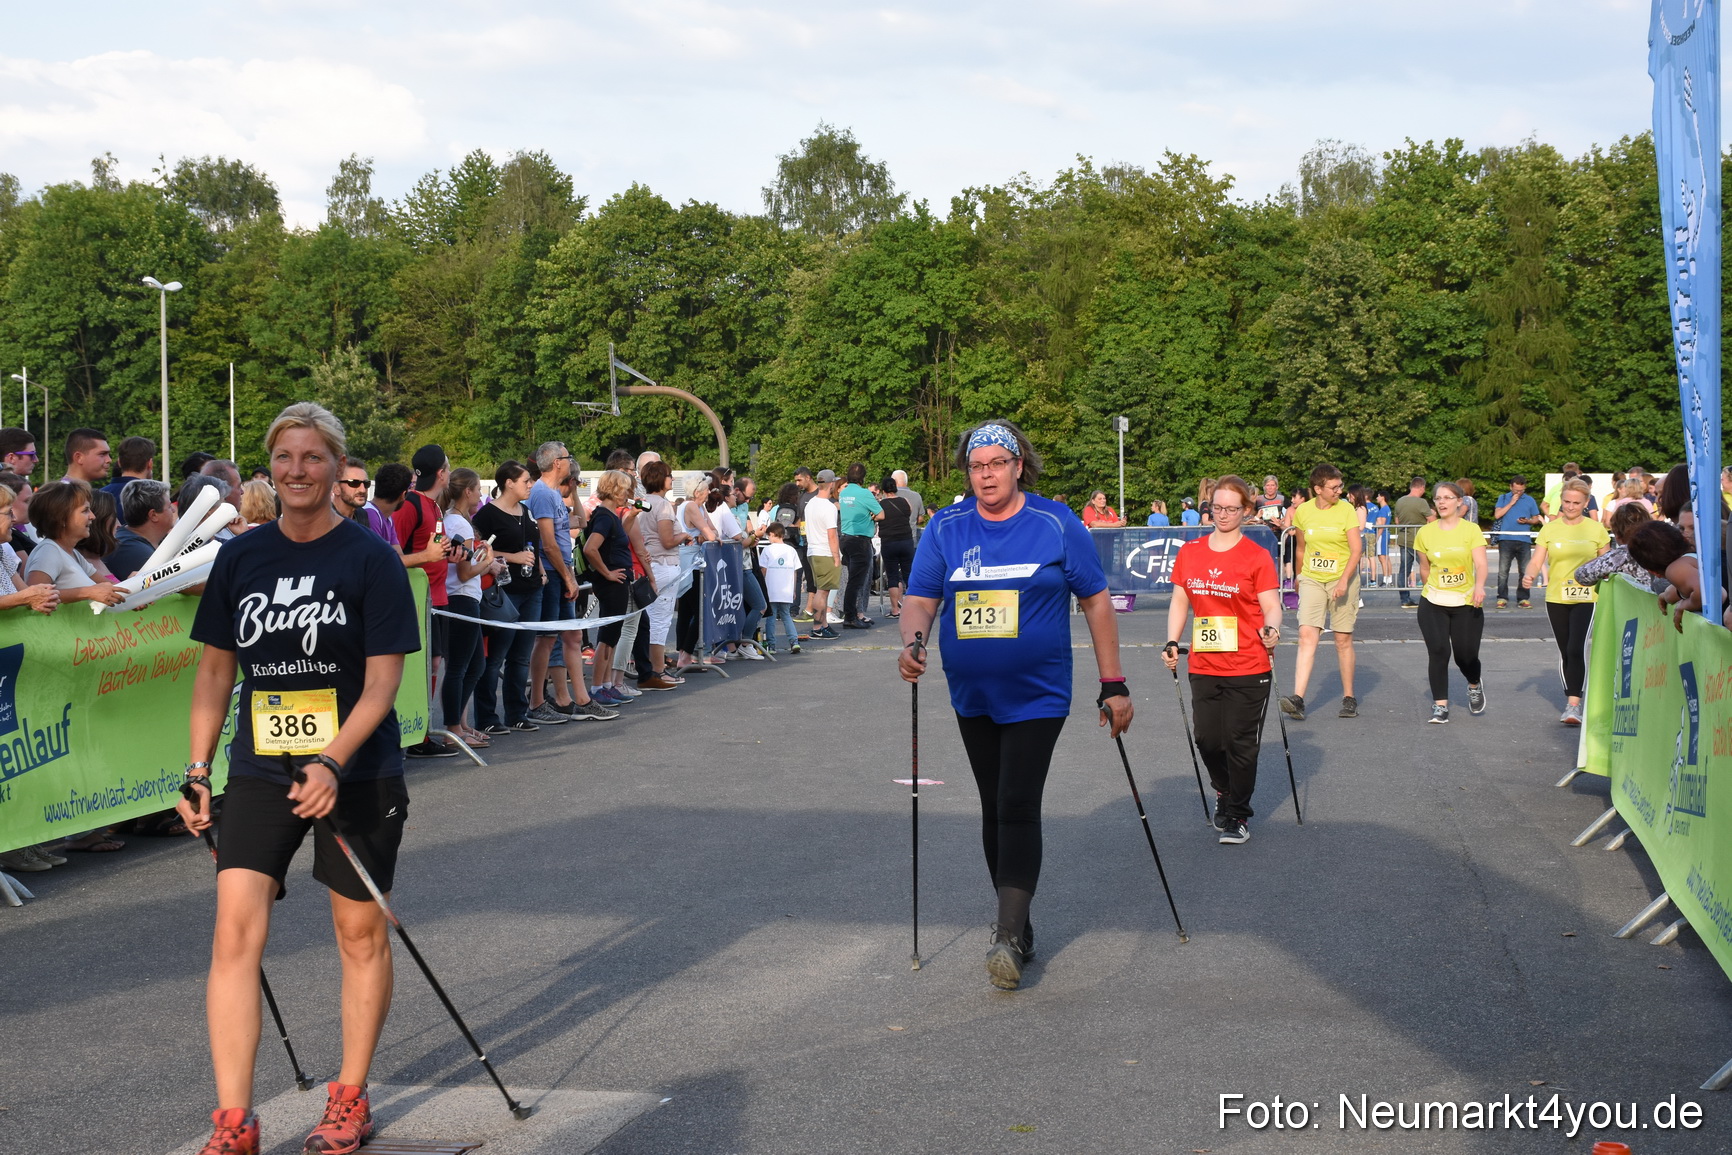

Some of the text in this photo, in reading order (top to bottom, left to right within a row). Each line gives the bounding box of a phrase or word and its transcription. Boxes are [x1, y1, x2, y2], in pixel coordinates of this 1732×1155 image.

[1312, 558, 1335, 568] 1207
[1441, 572, 1465, 583] 1230
[1565, 587, 1590, 596] 1274
[236, 590, 347, 657] Burgis
[962, 607, 1007, 625] 2131
[73, 615, 184, 666] Gesunde Firmen
[97, 657, 148, 696] laufen
[269, 714, 317, 737] 386
[265, 738, 292, 746] Dietmayr
